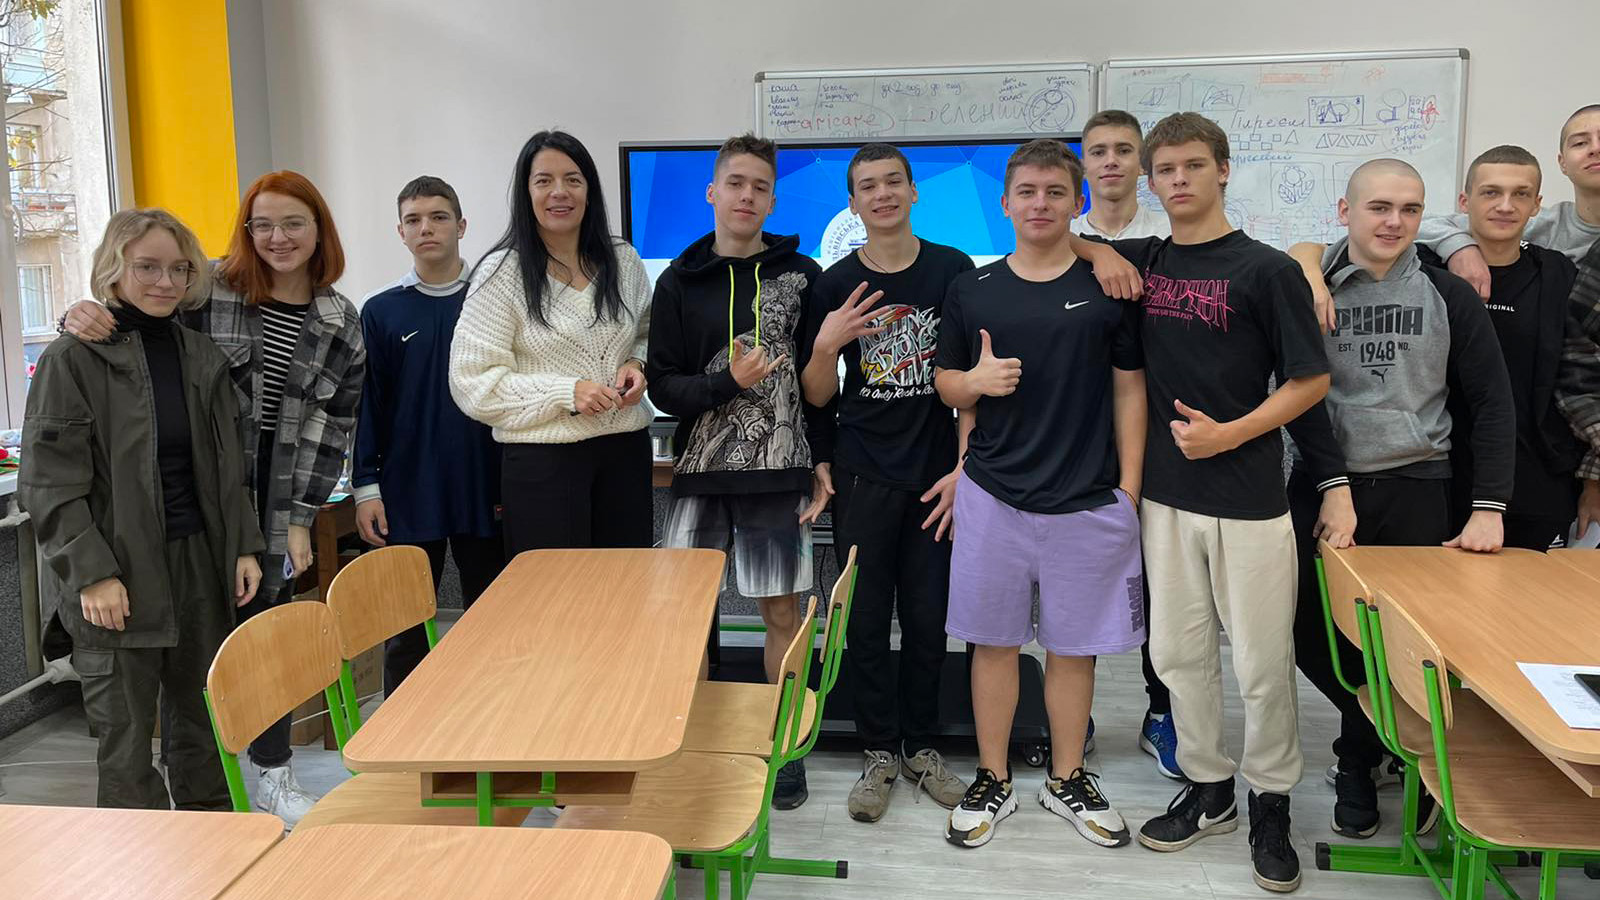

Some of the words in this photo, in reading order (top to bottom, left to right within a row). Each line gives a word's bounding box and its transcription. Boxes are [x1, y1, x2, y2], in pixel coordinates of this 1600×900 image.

[1484, 303, 1515, 312] RIGINAL
[1331, 304, 1423, 337] PUMA
[1360, 340, 1396, 363] 1948
